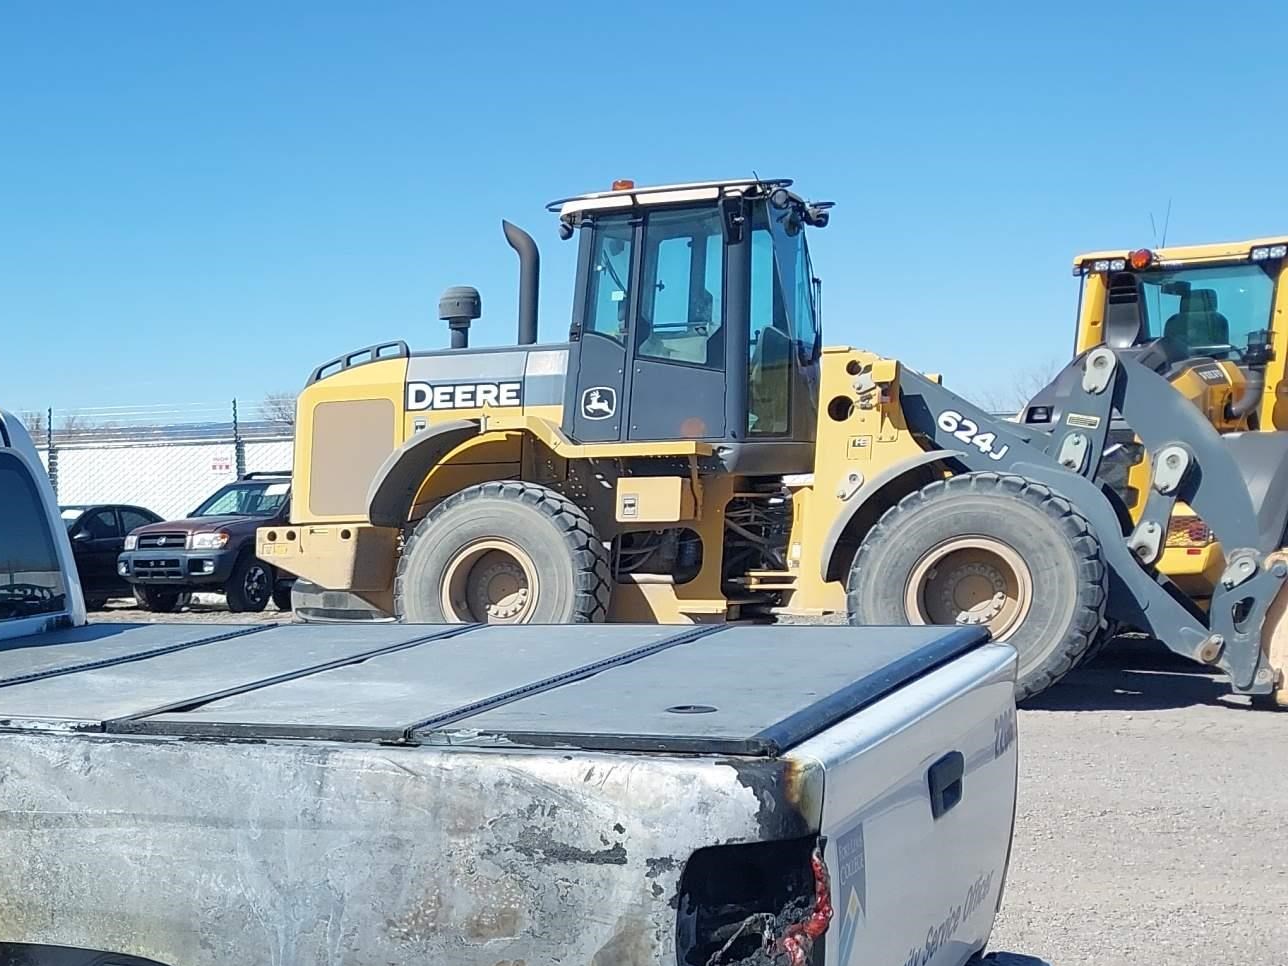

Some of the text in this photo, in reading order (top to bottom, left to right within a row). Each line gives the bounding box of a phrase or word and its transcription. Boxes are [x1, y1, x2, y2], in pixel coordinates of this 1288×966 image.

[408, 382, 521, 410] DEERE
[938, 411, 1009, 461] 624J
[921, 905, 963, 966] Service
